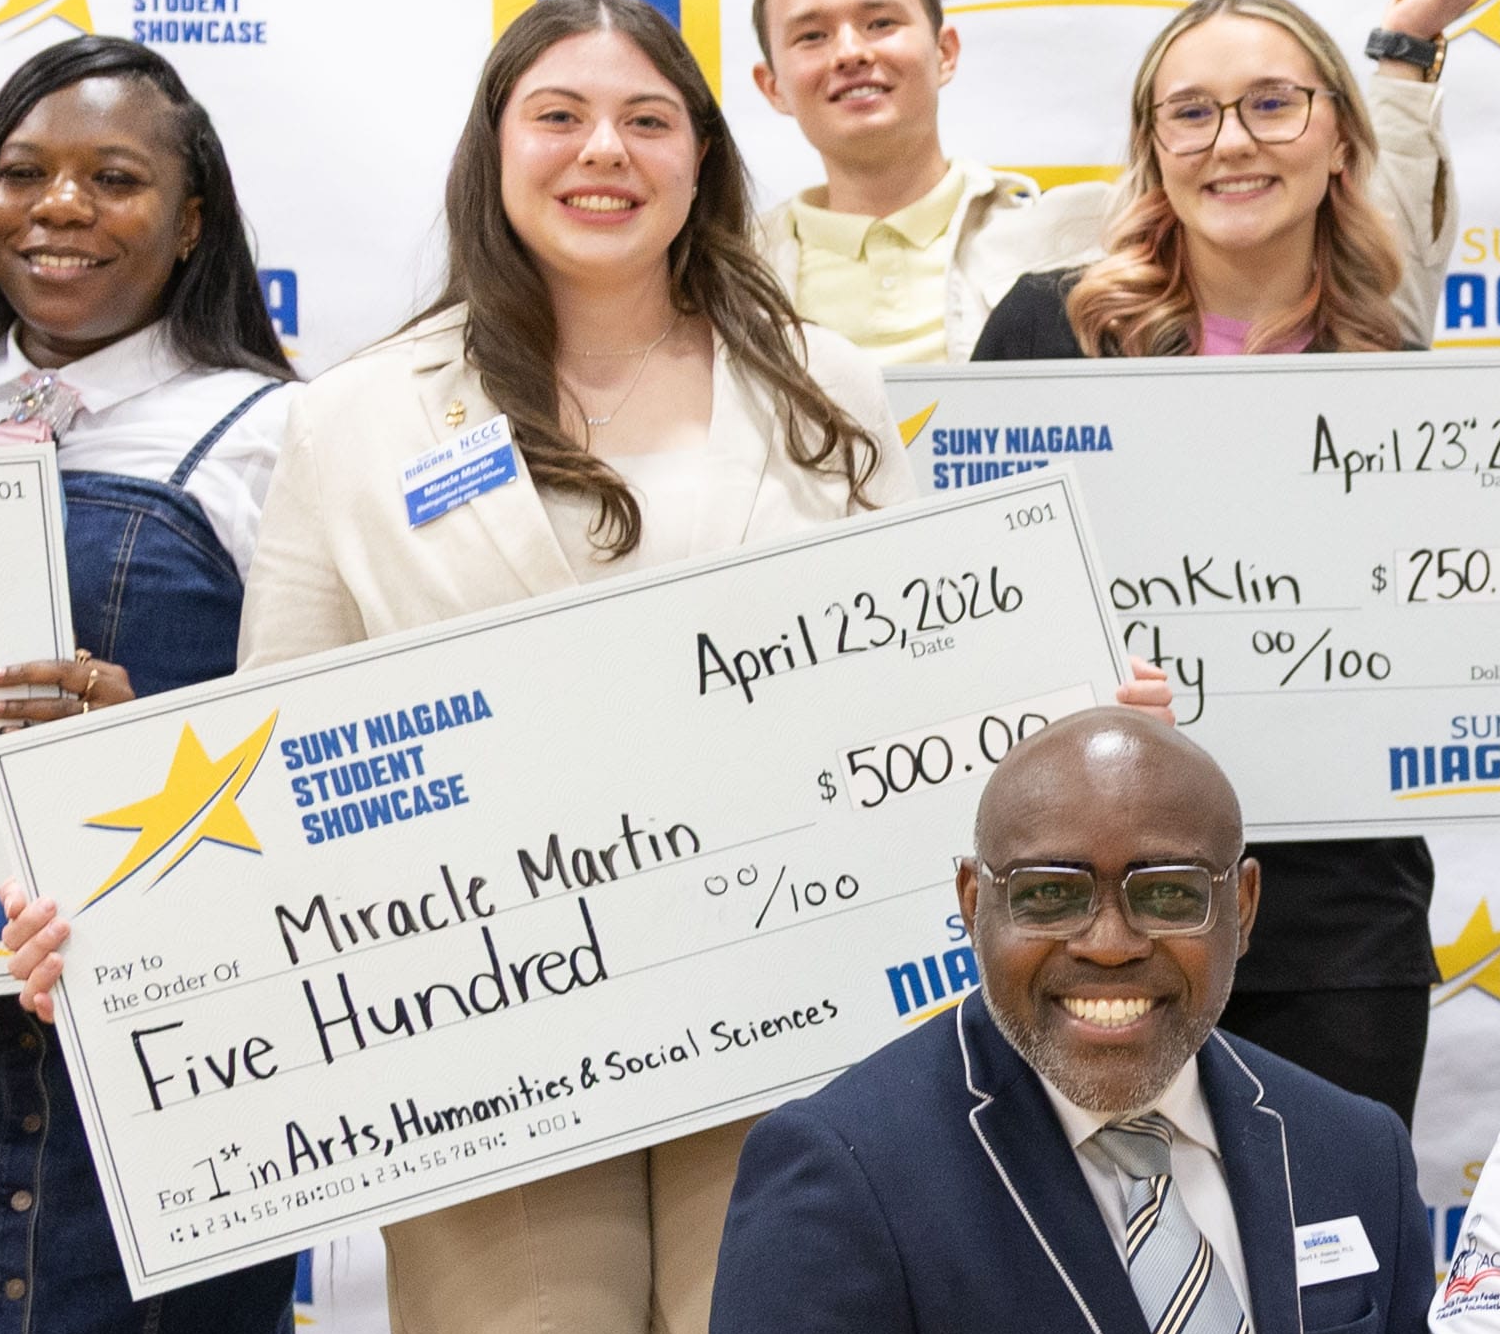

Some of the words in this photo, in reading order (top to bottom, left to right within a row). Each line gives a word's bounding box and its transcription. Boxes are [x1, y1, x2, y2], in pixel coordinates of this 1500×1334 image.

[134, 19, 267, 44] SHOWCASE
[933, 429, 999, 456] SUNY
[1006, 424, 1113, 454] NIAGARA
[1313, 414, 1400, 492] April
[1003, 504, 1057, 532] 1001
[697, 616, 818, 703] April
[911, 634, 955, 659] Date
[281, 722, 359, 771] SUNY
[364, 690, 493, 750] NIAGARA
[291, 744, 425, 808] STUDENT
[302, 775, 469, 845] SHOWCASE
[275, 865, 496, 965] Miracle
[517, 814, 701, 900] Martin
[131, 1020, 279, 1112] Five
[303, 896, 608, 1065] Hundred
[605, 1031, 701, 1082] Social
[710, 999, 839, 1052] Sciences
[158, 1186, 194, 1212] For
